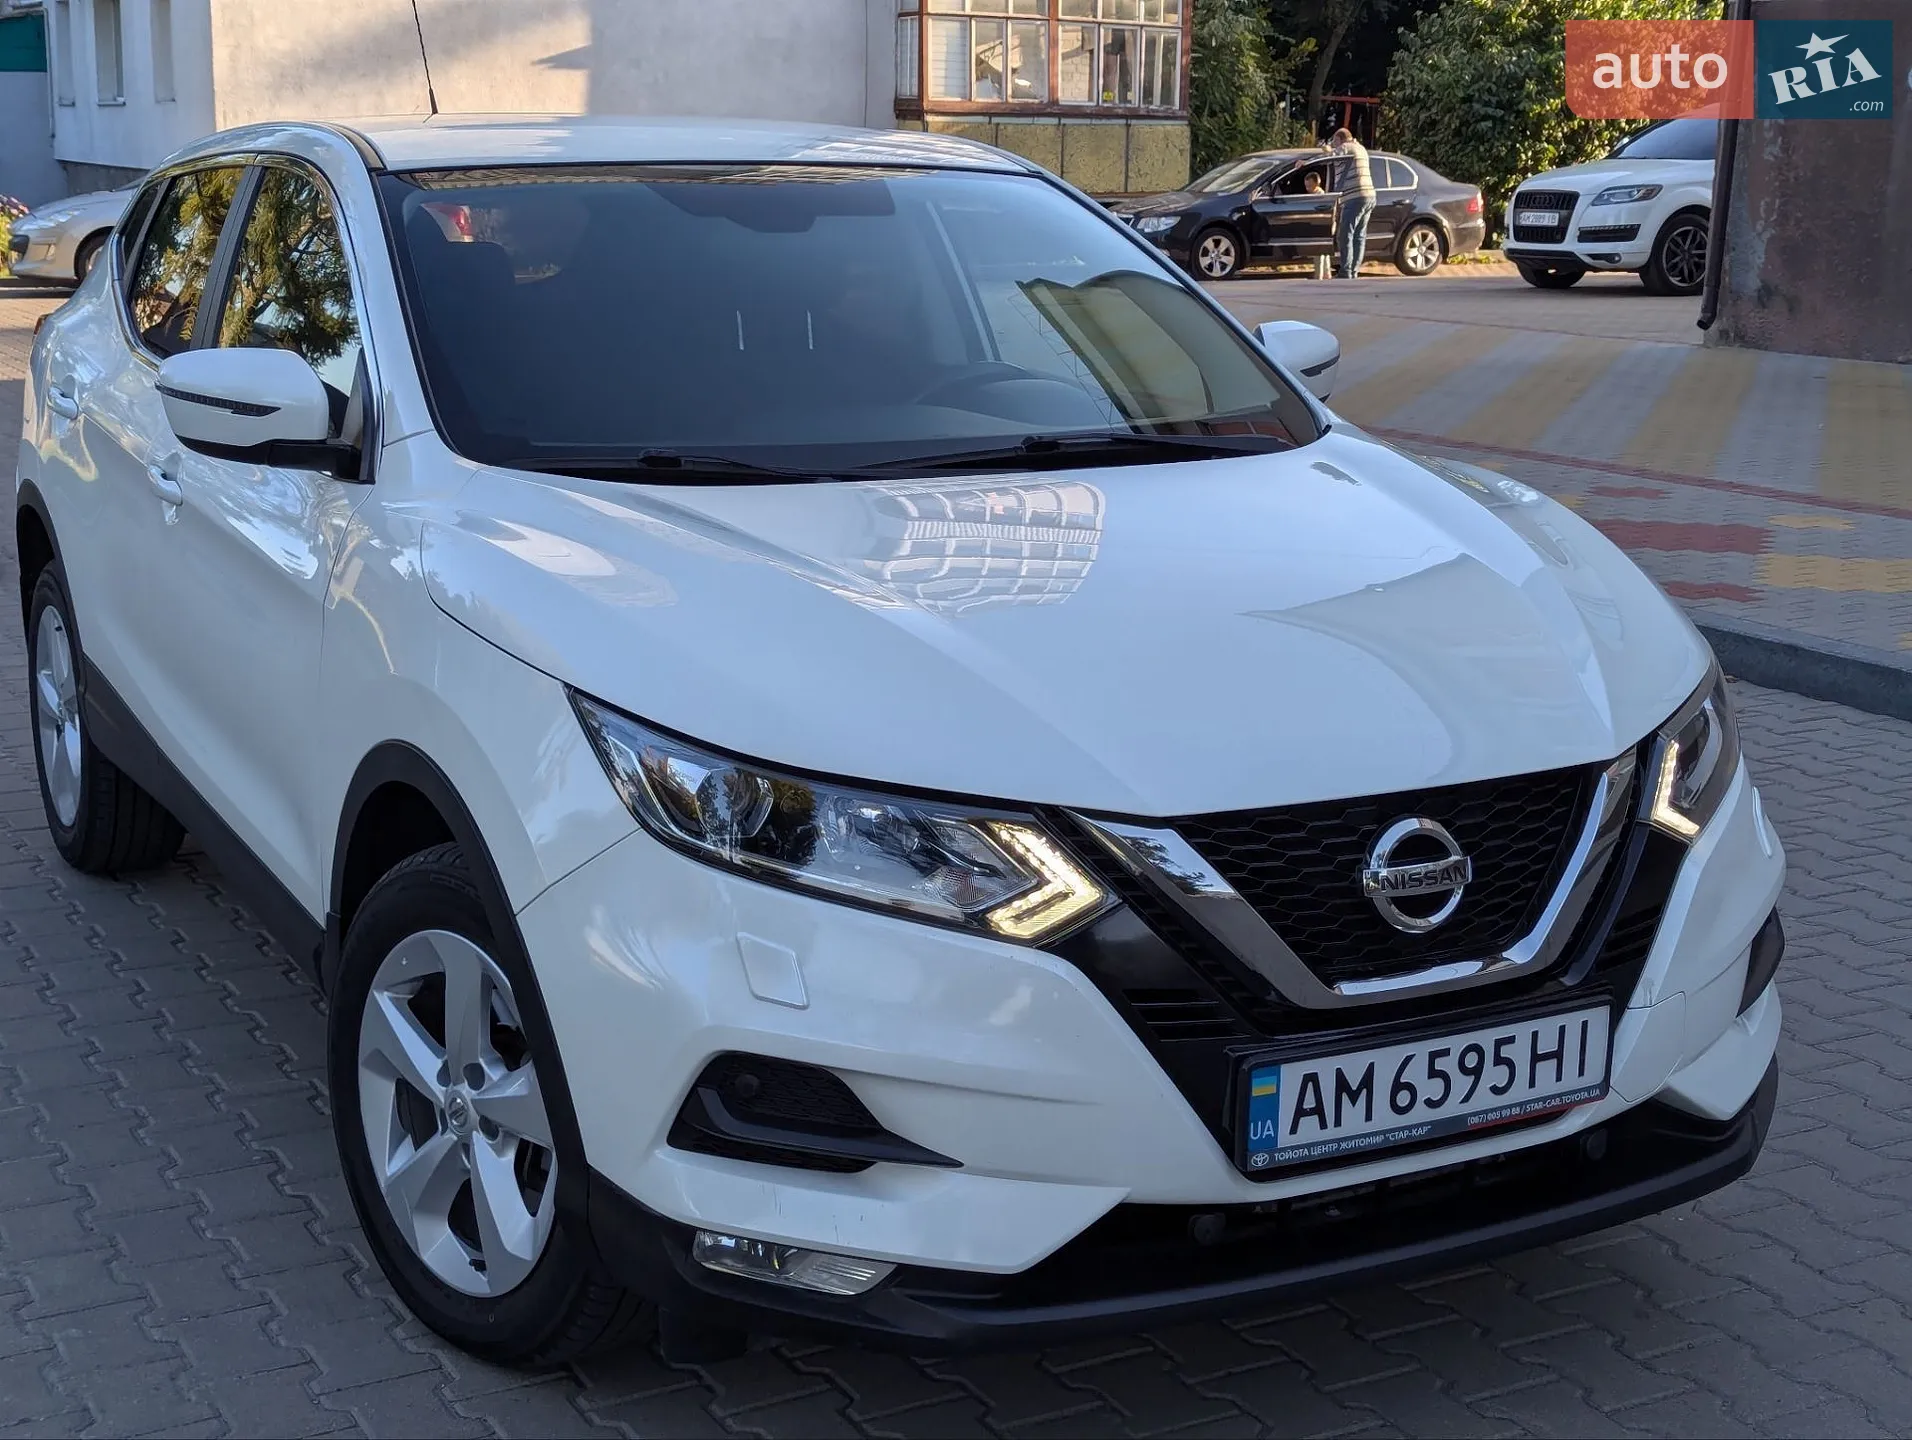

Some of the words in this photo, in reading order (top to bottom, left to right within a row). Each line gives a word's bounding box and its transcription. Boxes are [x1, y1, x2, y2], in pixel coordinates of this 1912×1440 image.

[1380, 864, 1467, 891] NISSAN
[1250, 1119, 1275, 1140] UA
[1274, 1148, 1309, 1162] ТОЙОТА
[1310, 1142, 1339, 1156] ЦЕНТР
[1339, 1134, 1384, 1150] ЖИТОМИР
